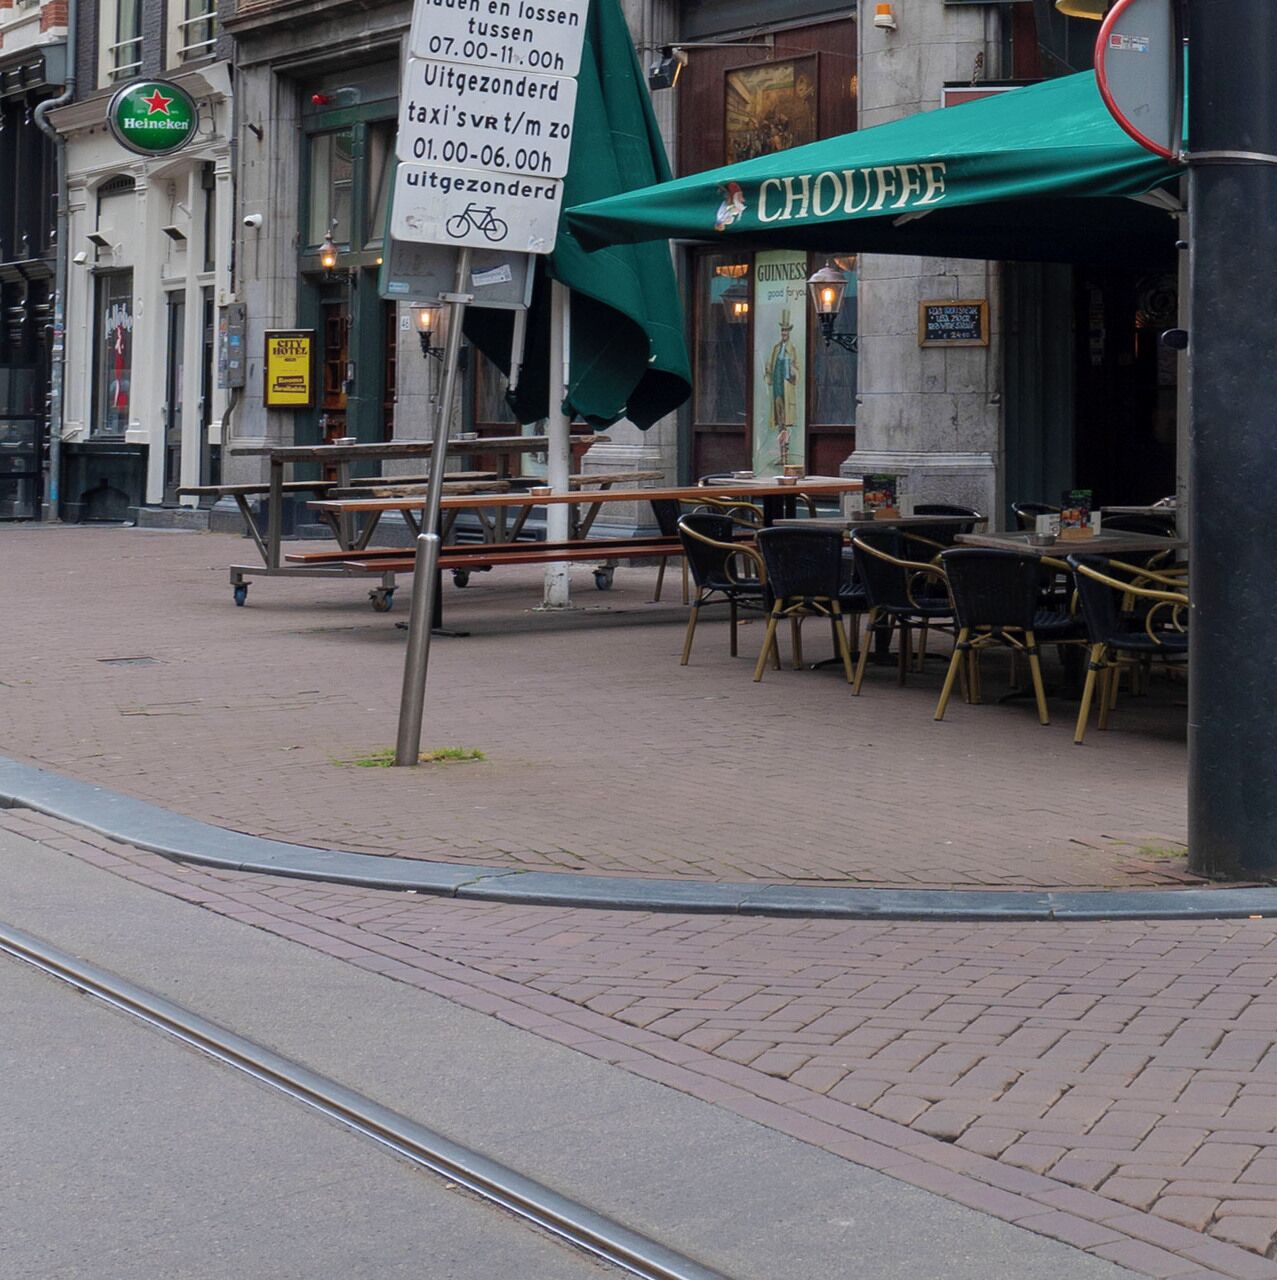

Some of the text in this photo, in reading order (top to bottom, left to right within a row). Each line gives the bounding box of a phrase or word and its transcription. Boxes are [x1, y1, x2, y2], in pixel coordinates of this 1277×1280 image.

[488, 2, 510, 16] en
[519, 1, 579, 26] lossen
[468, 17, 533, 42] tussen
[429, 36, 564, 70] 07.00-11.00h
[424, 64, 559, 101] Uitgezonderd
[124, 118, 188, 130] Heineken
[408, 100, 570, 139] taxi's VR t/m zo
[413, 137, 552, 172] 01.00-06.00h
[406, 171, 557, 200] uitgezonderd
[758, 162, 946, 222] CHOUFFE
[757, 262, 807, 282] GUINNESS
[768, 286, 784, 301] good
[273, 347, 307, 355] HOTEL
